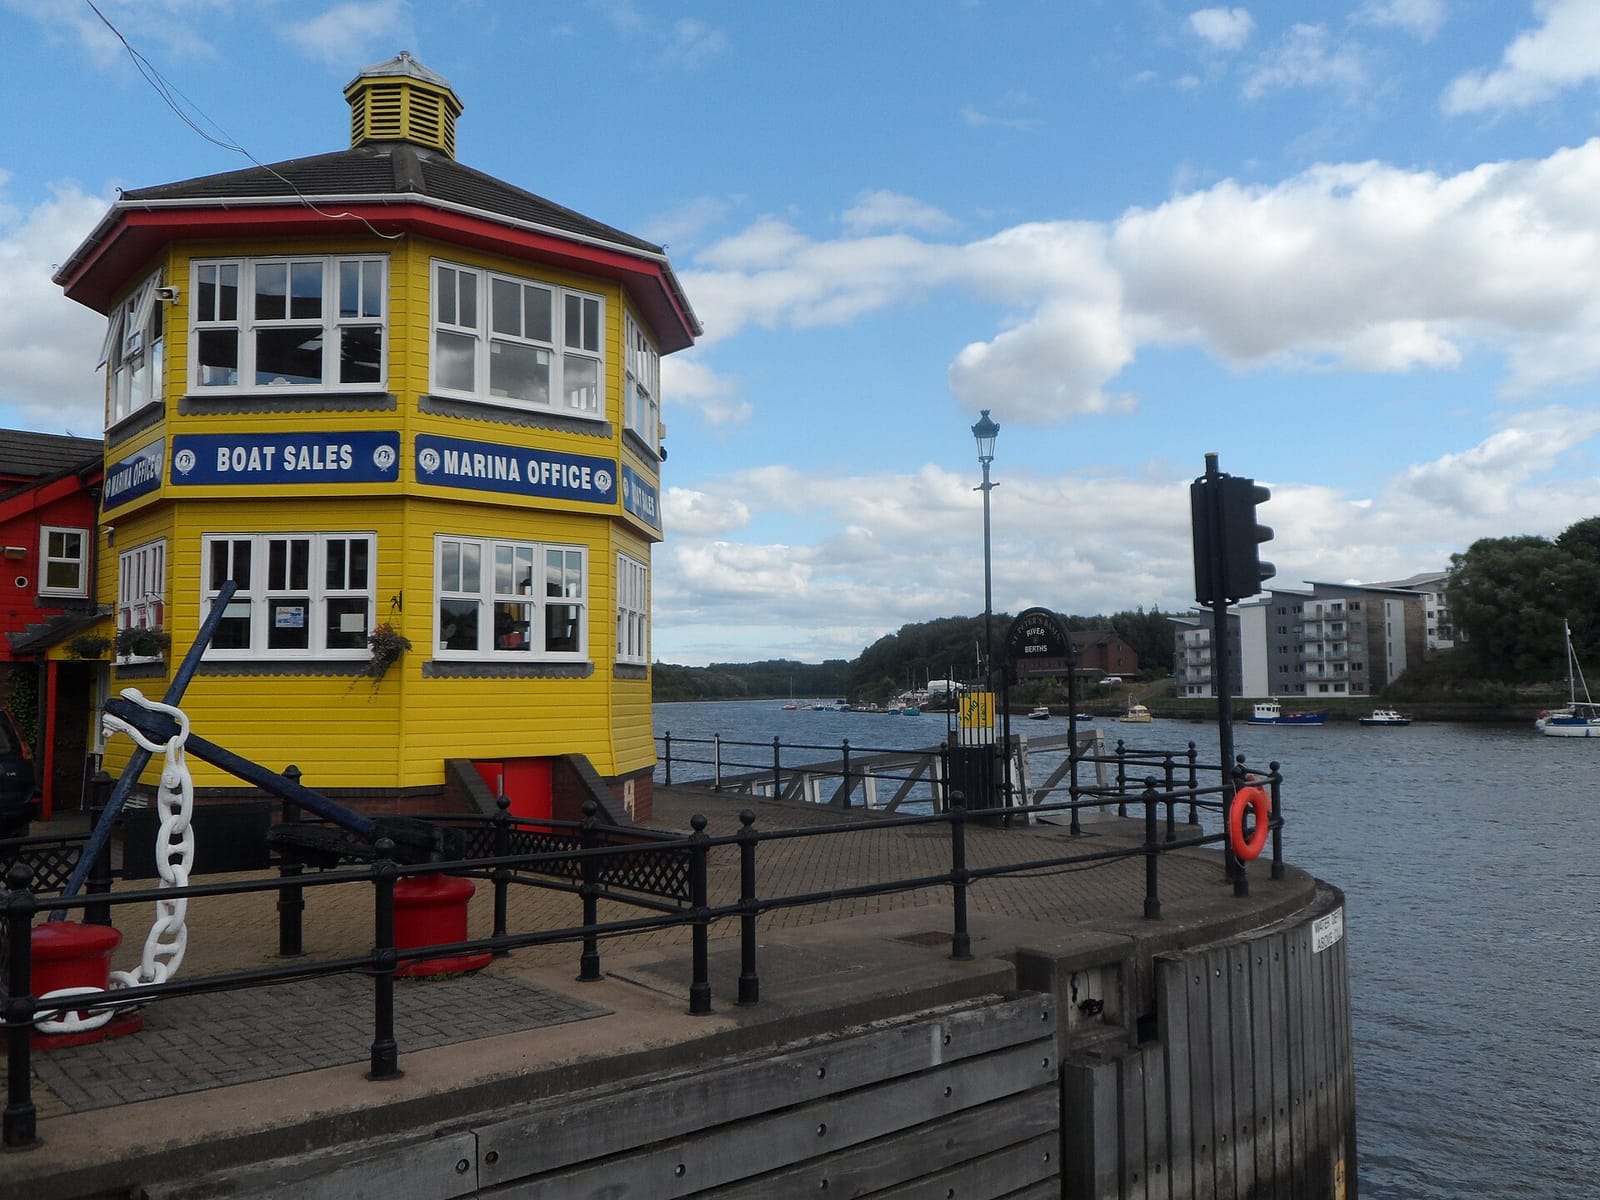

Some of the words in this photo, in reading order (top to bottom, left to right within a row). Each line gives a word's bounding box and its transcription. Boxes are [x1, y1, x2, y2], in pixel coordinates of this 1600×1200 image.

[217, 446, 275, 472] BOAT
[283, 444, 353, 471] SALES
[443, 449, 520, 482] MARINA
[527, 460, 592, 490] OFFICE
[111, 466, 132, 496] MARINA
[133, 454, 155, 486] OFFICE
[1026, 627, 1045, 637] RIVER
[1024, 644, 1048, 653] BERTHS
